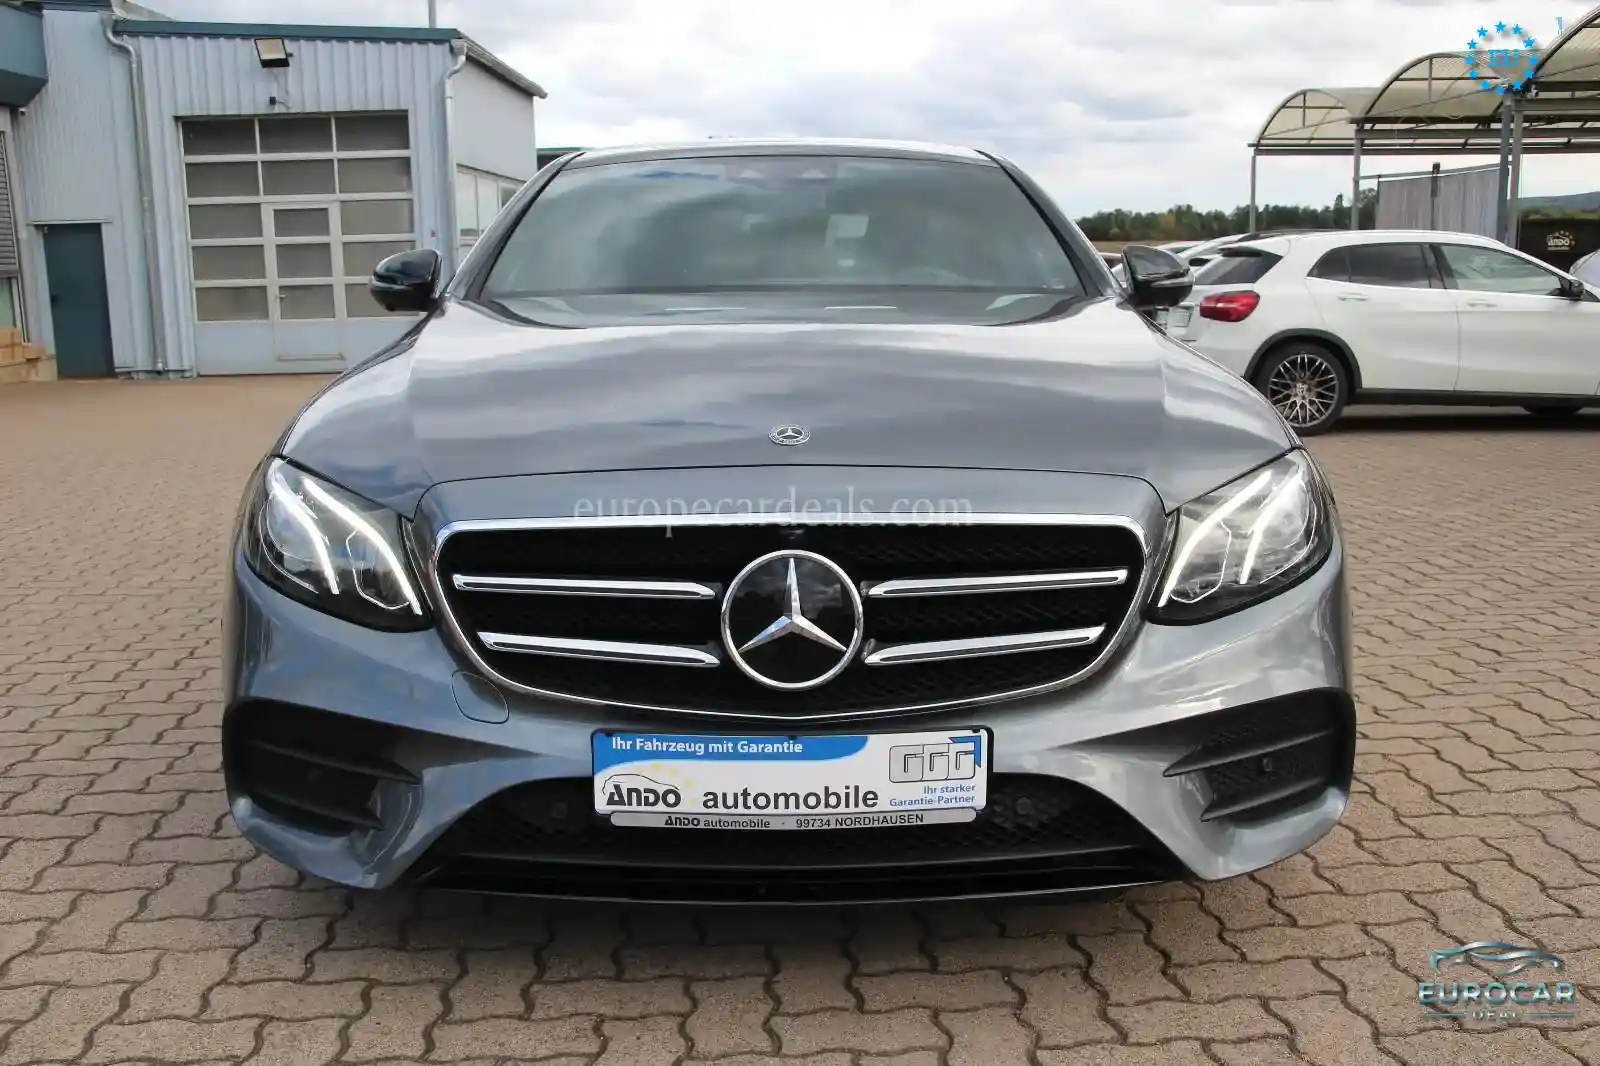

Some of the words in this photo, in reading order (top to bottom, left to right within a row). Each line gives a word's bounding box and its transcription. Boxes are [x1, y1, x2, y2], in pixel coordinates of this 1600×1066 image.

[612, 737, 631, 750] Ihr
[636, 738, 705, 755] Fahrzeug
[708, 740, 734, 753] mit
[737, 740, 803, 753] Garantie
[702, 785, 879, 810] automobile
[923, 785, 938, 795] Ihr
[940, 784, 976, 794] starker
[703, 816, 771, 829] automobile
[795, 818, 832, 829] 99734
[834, 813, 924, 828] NORDHAUSEN
